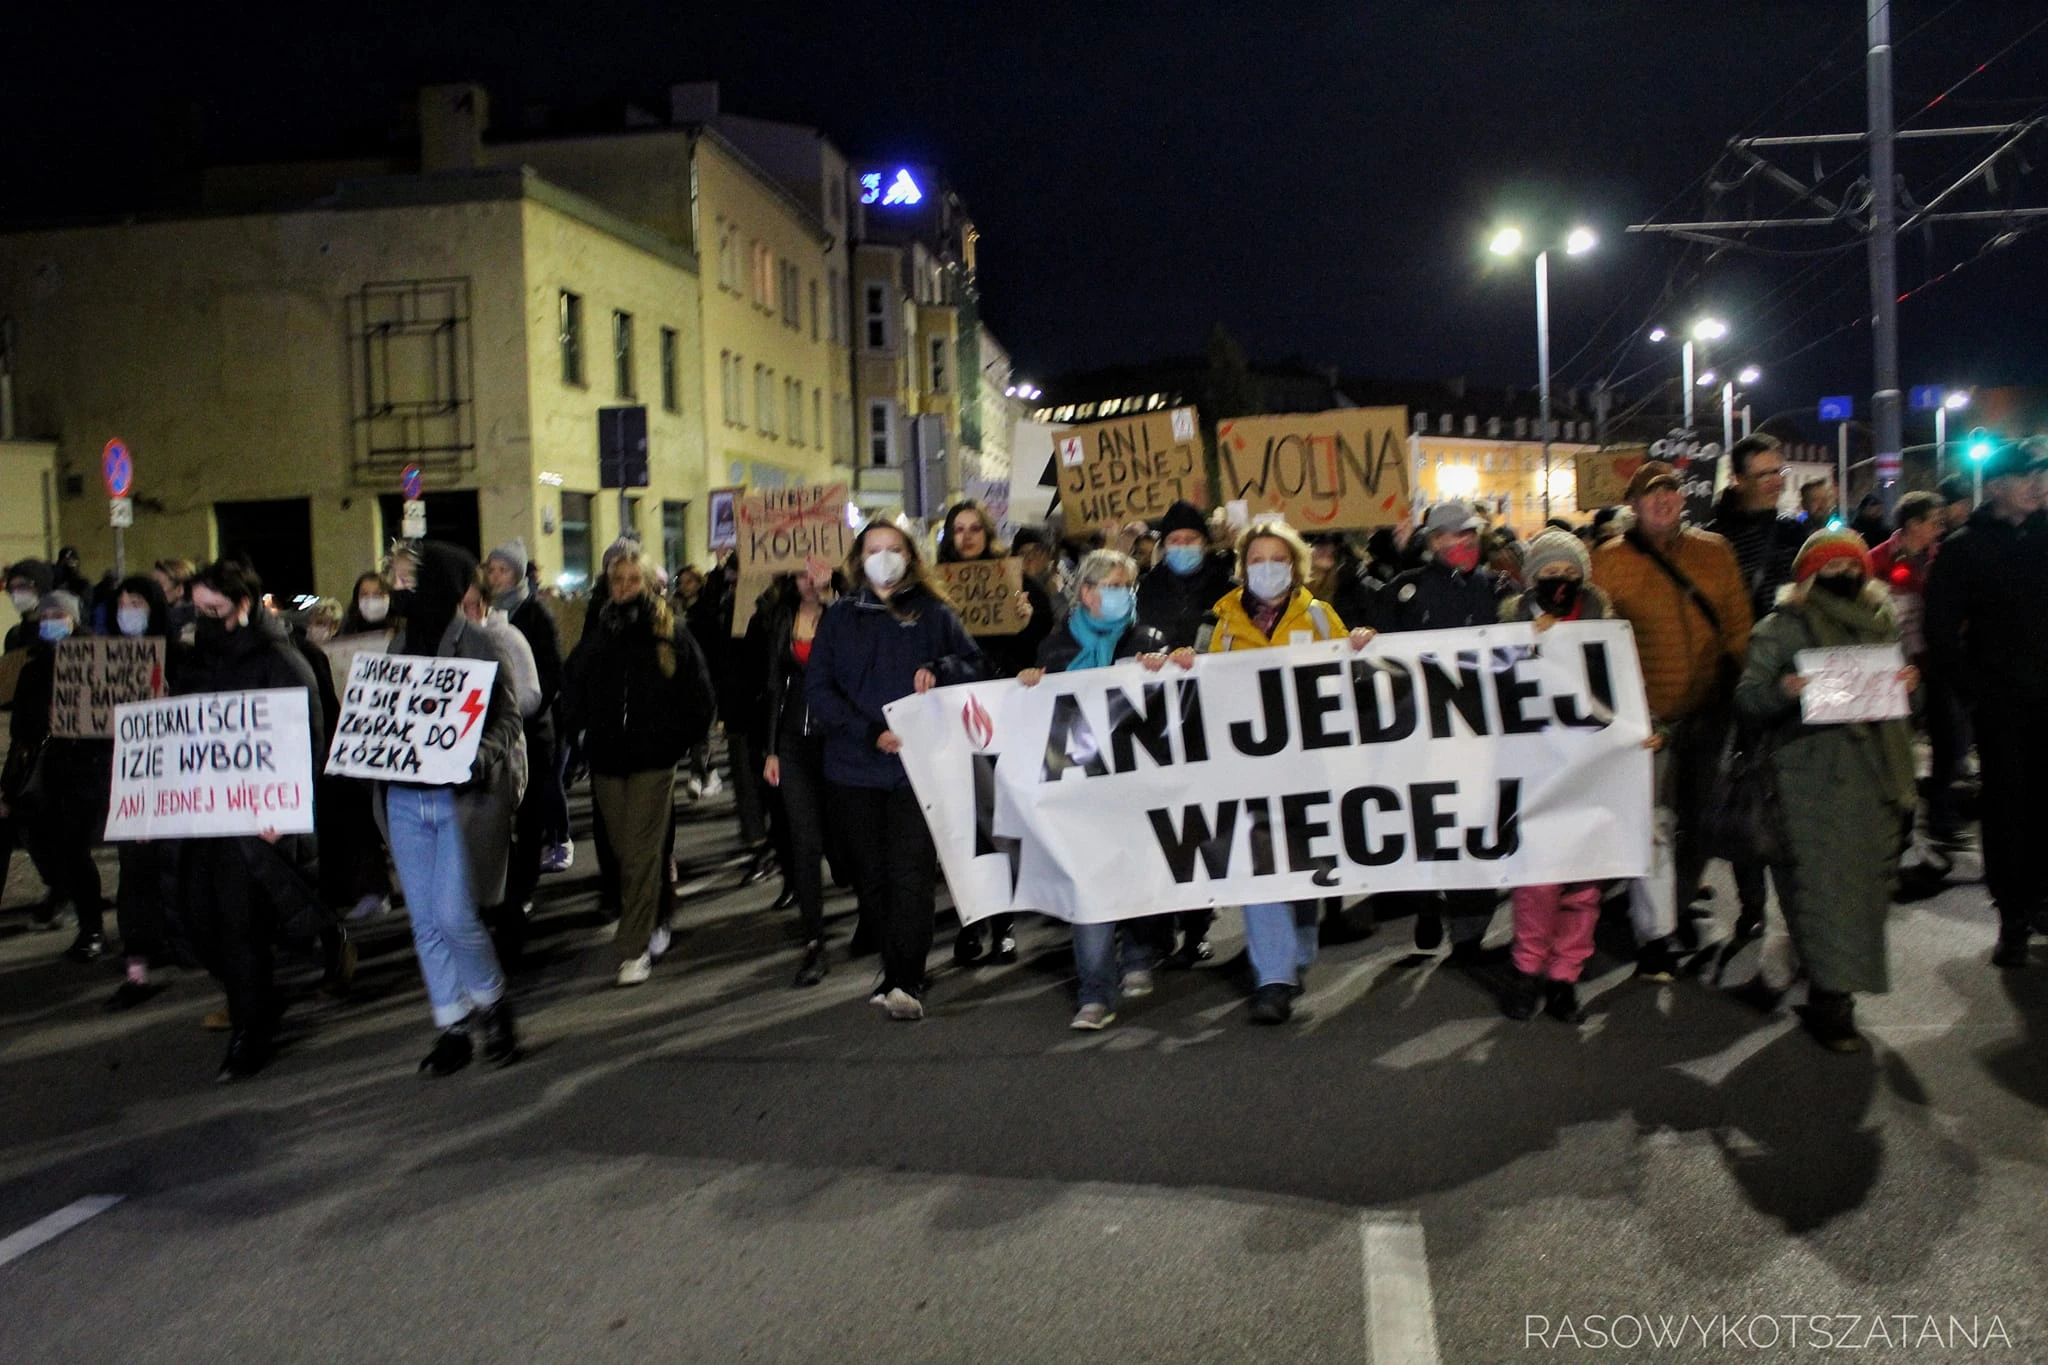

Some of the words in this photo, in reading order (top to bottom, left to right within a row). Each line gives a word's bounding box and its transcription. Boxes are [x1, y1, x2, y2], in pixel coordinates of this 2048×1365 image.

[1098, 419, 1151, 462] ANI
[1067, 443, 1194, 494] JEDNEJ
[422, 660, 469, 693] ŻEBY
[348, 688, 363, 702] CI
[369, 690, 400, 716] SIĘ
[408, 694, 454, 718] KOT
[1042, 675, 1209, 783] ANI
[1229, 640, 1617, 758] JEDNEJ
[179, 732, 277, 775] WYBÓR
[425, 725, 458, 750] DO
[115, 787, 145, 820] ANI
[153, 785, 215, 818] JEDNEJ
[226, 779, 301, 816] WIĘCEJ
[1147, 778, 1521, 887] WIĘCEJ
